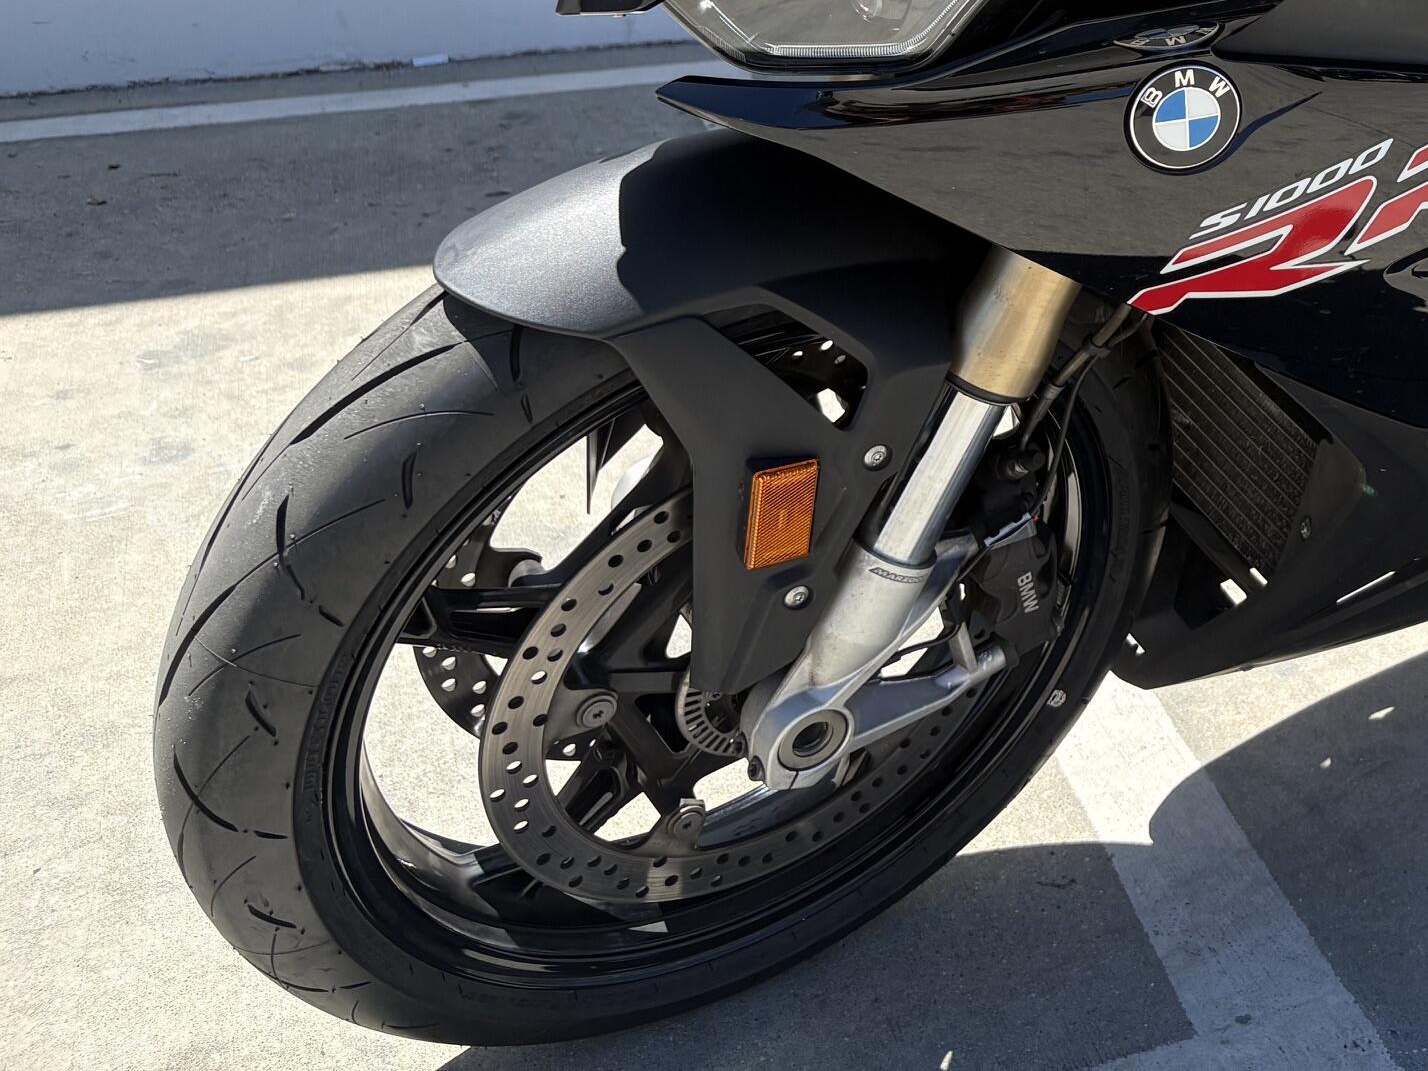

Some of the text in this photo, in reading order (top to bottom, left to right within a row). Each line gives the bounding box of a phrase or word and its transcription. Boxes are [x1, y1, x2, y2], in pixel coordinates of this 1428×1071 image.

[1141, 69, 1231, 108] BMW
[1189, 137, 1394, 239] S1000
[1017, 571, 1039, 613] BMW
